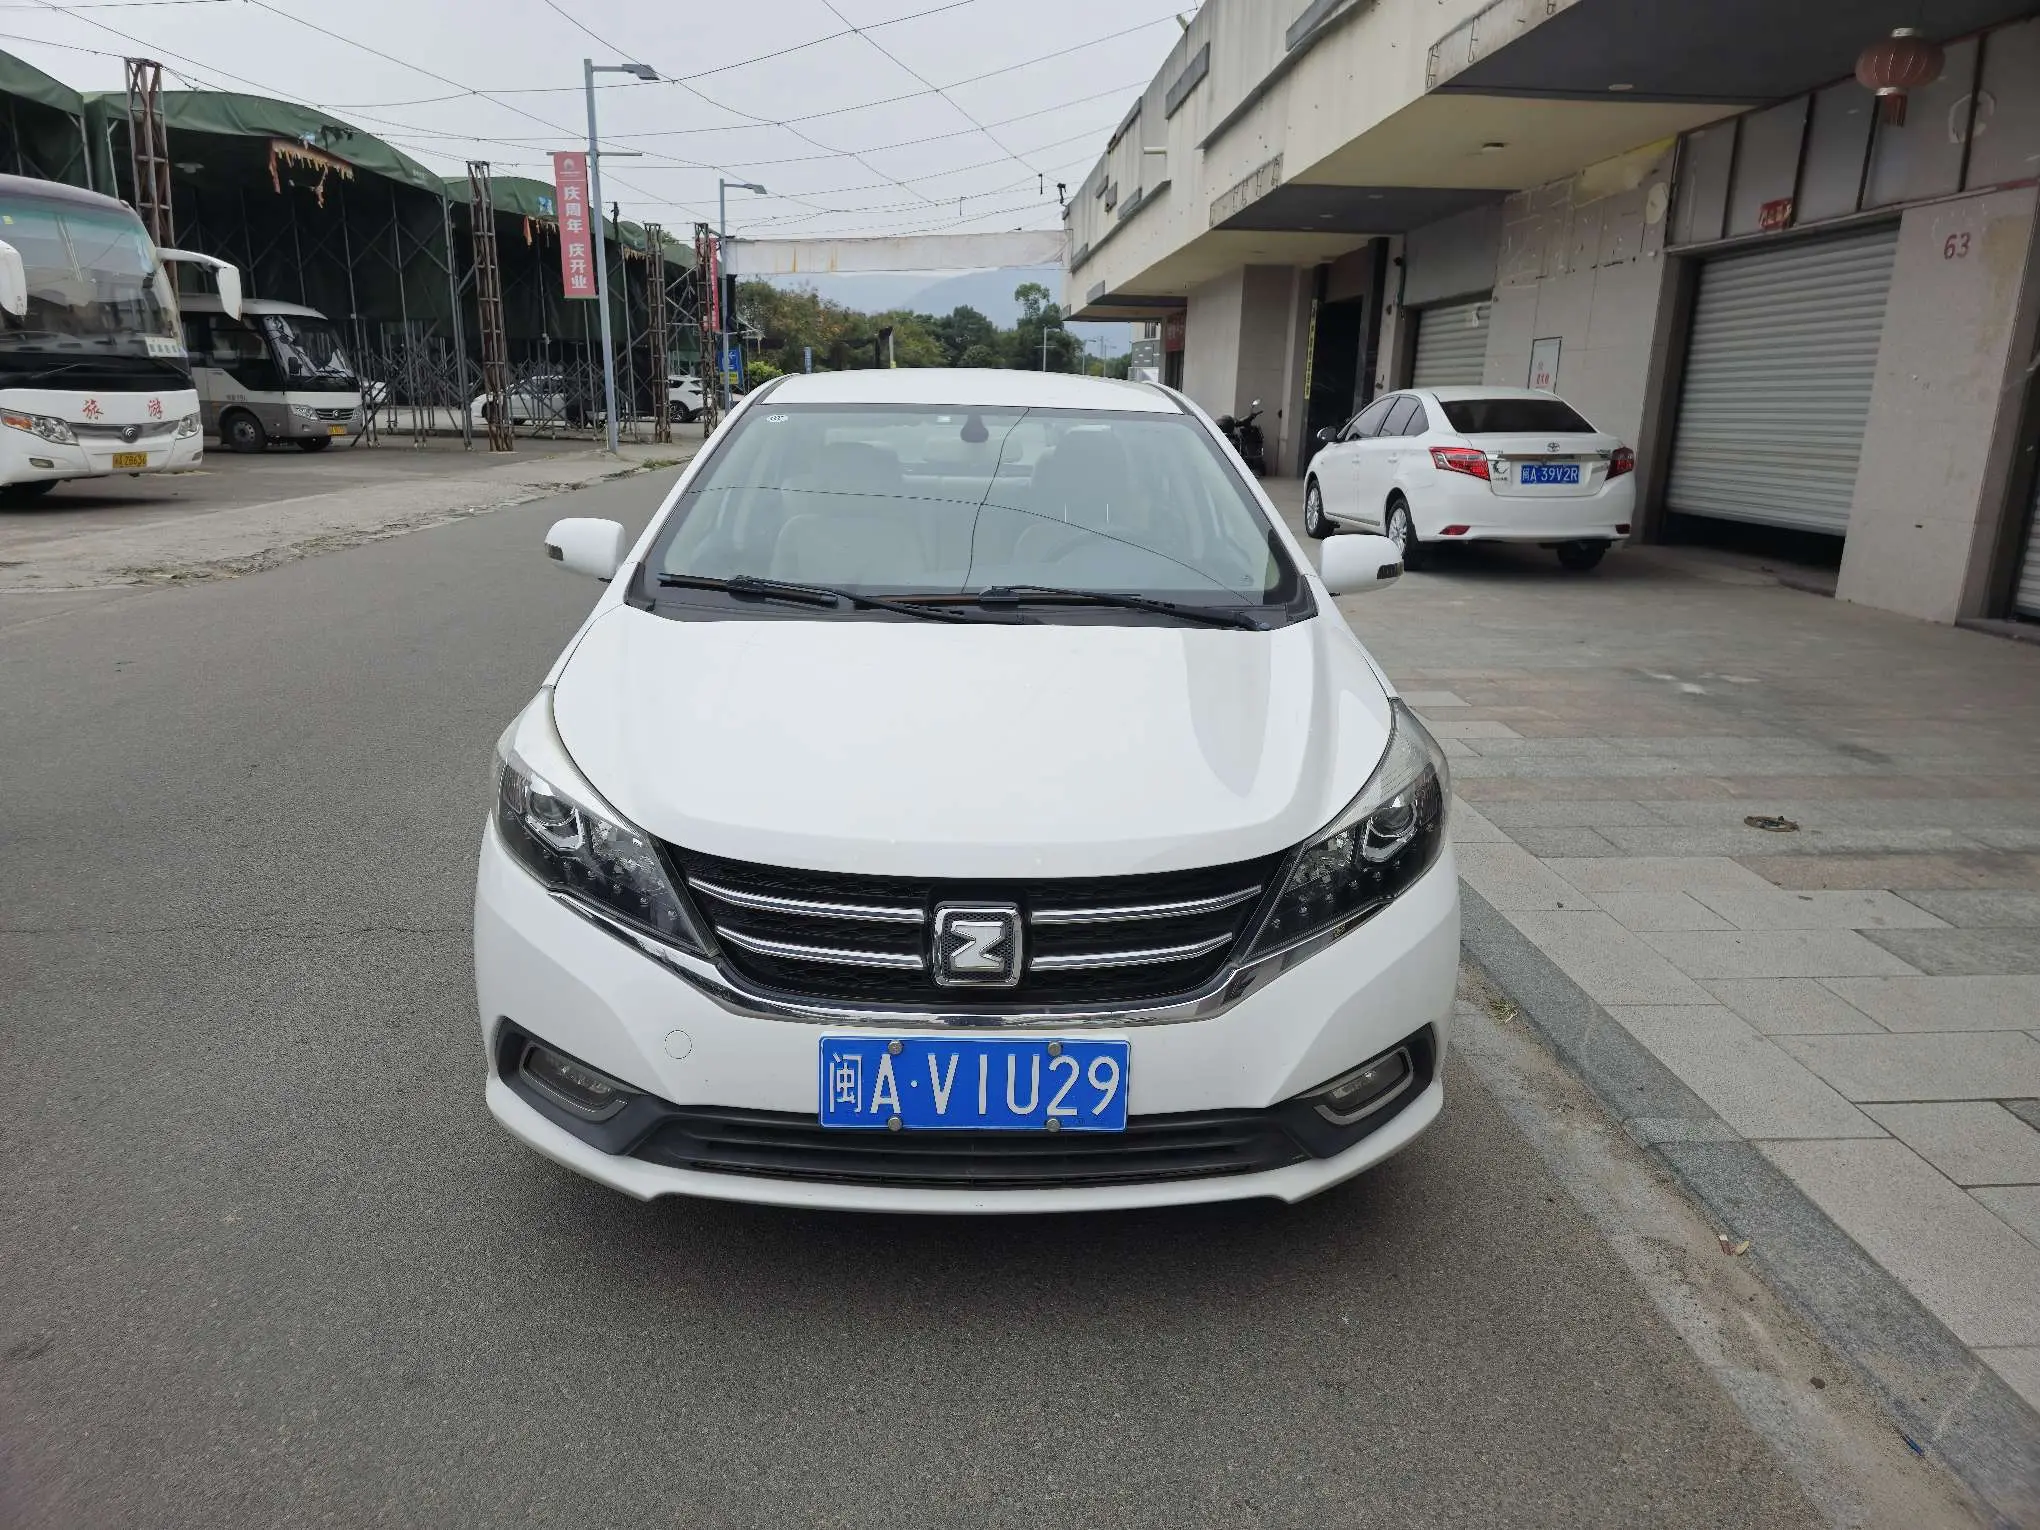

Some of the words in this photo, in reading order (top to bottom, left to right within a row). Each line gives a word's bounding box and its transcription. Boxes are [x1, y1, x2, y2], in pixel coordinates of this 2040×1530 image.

[563, 186, 584, 233] 庆周年
[1943, 232, 1971, 260] 63
[568, 243, 588, 289] 庆开业
[82, 398, 164, 420] 旅游
